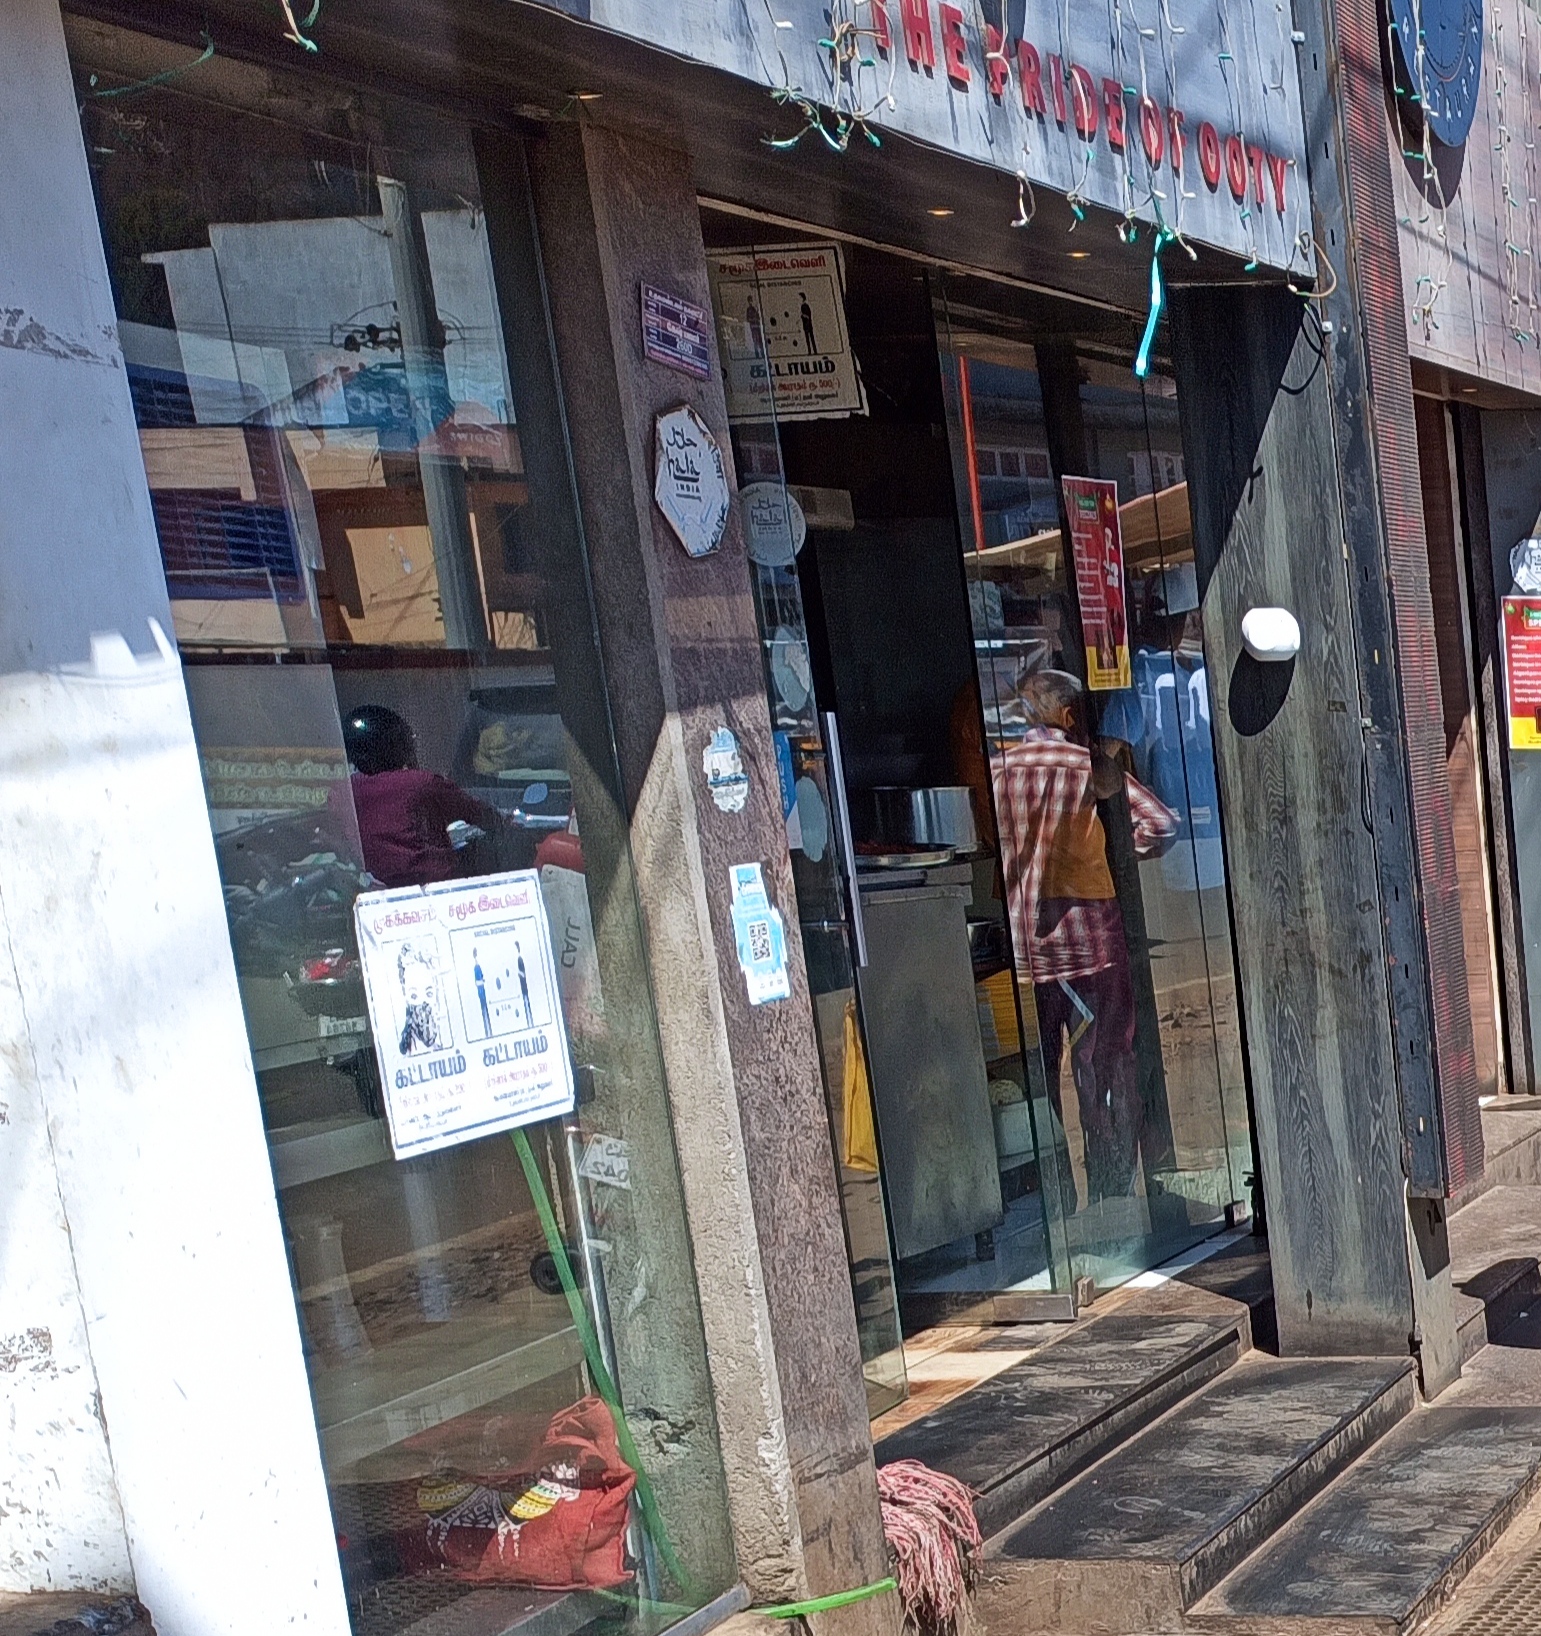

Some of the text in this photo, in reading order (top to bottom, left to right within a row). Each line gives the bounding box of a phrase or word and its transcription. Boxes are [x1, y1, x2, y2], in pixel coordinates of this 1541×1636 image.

[985, 24, 1126, 148] PRIDE
[1138, 97, 1187, 172] OF
[1197, 121, 1288, 212] OOTY
[665, 446, 702, 480] hala
[676, 483, 701, 494] INDIA
[448, 898, 477, 922] சமூக
[395, 1029, 549, 1090] கட்டாயம் கட்டாயம்
